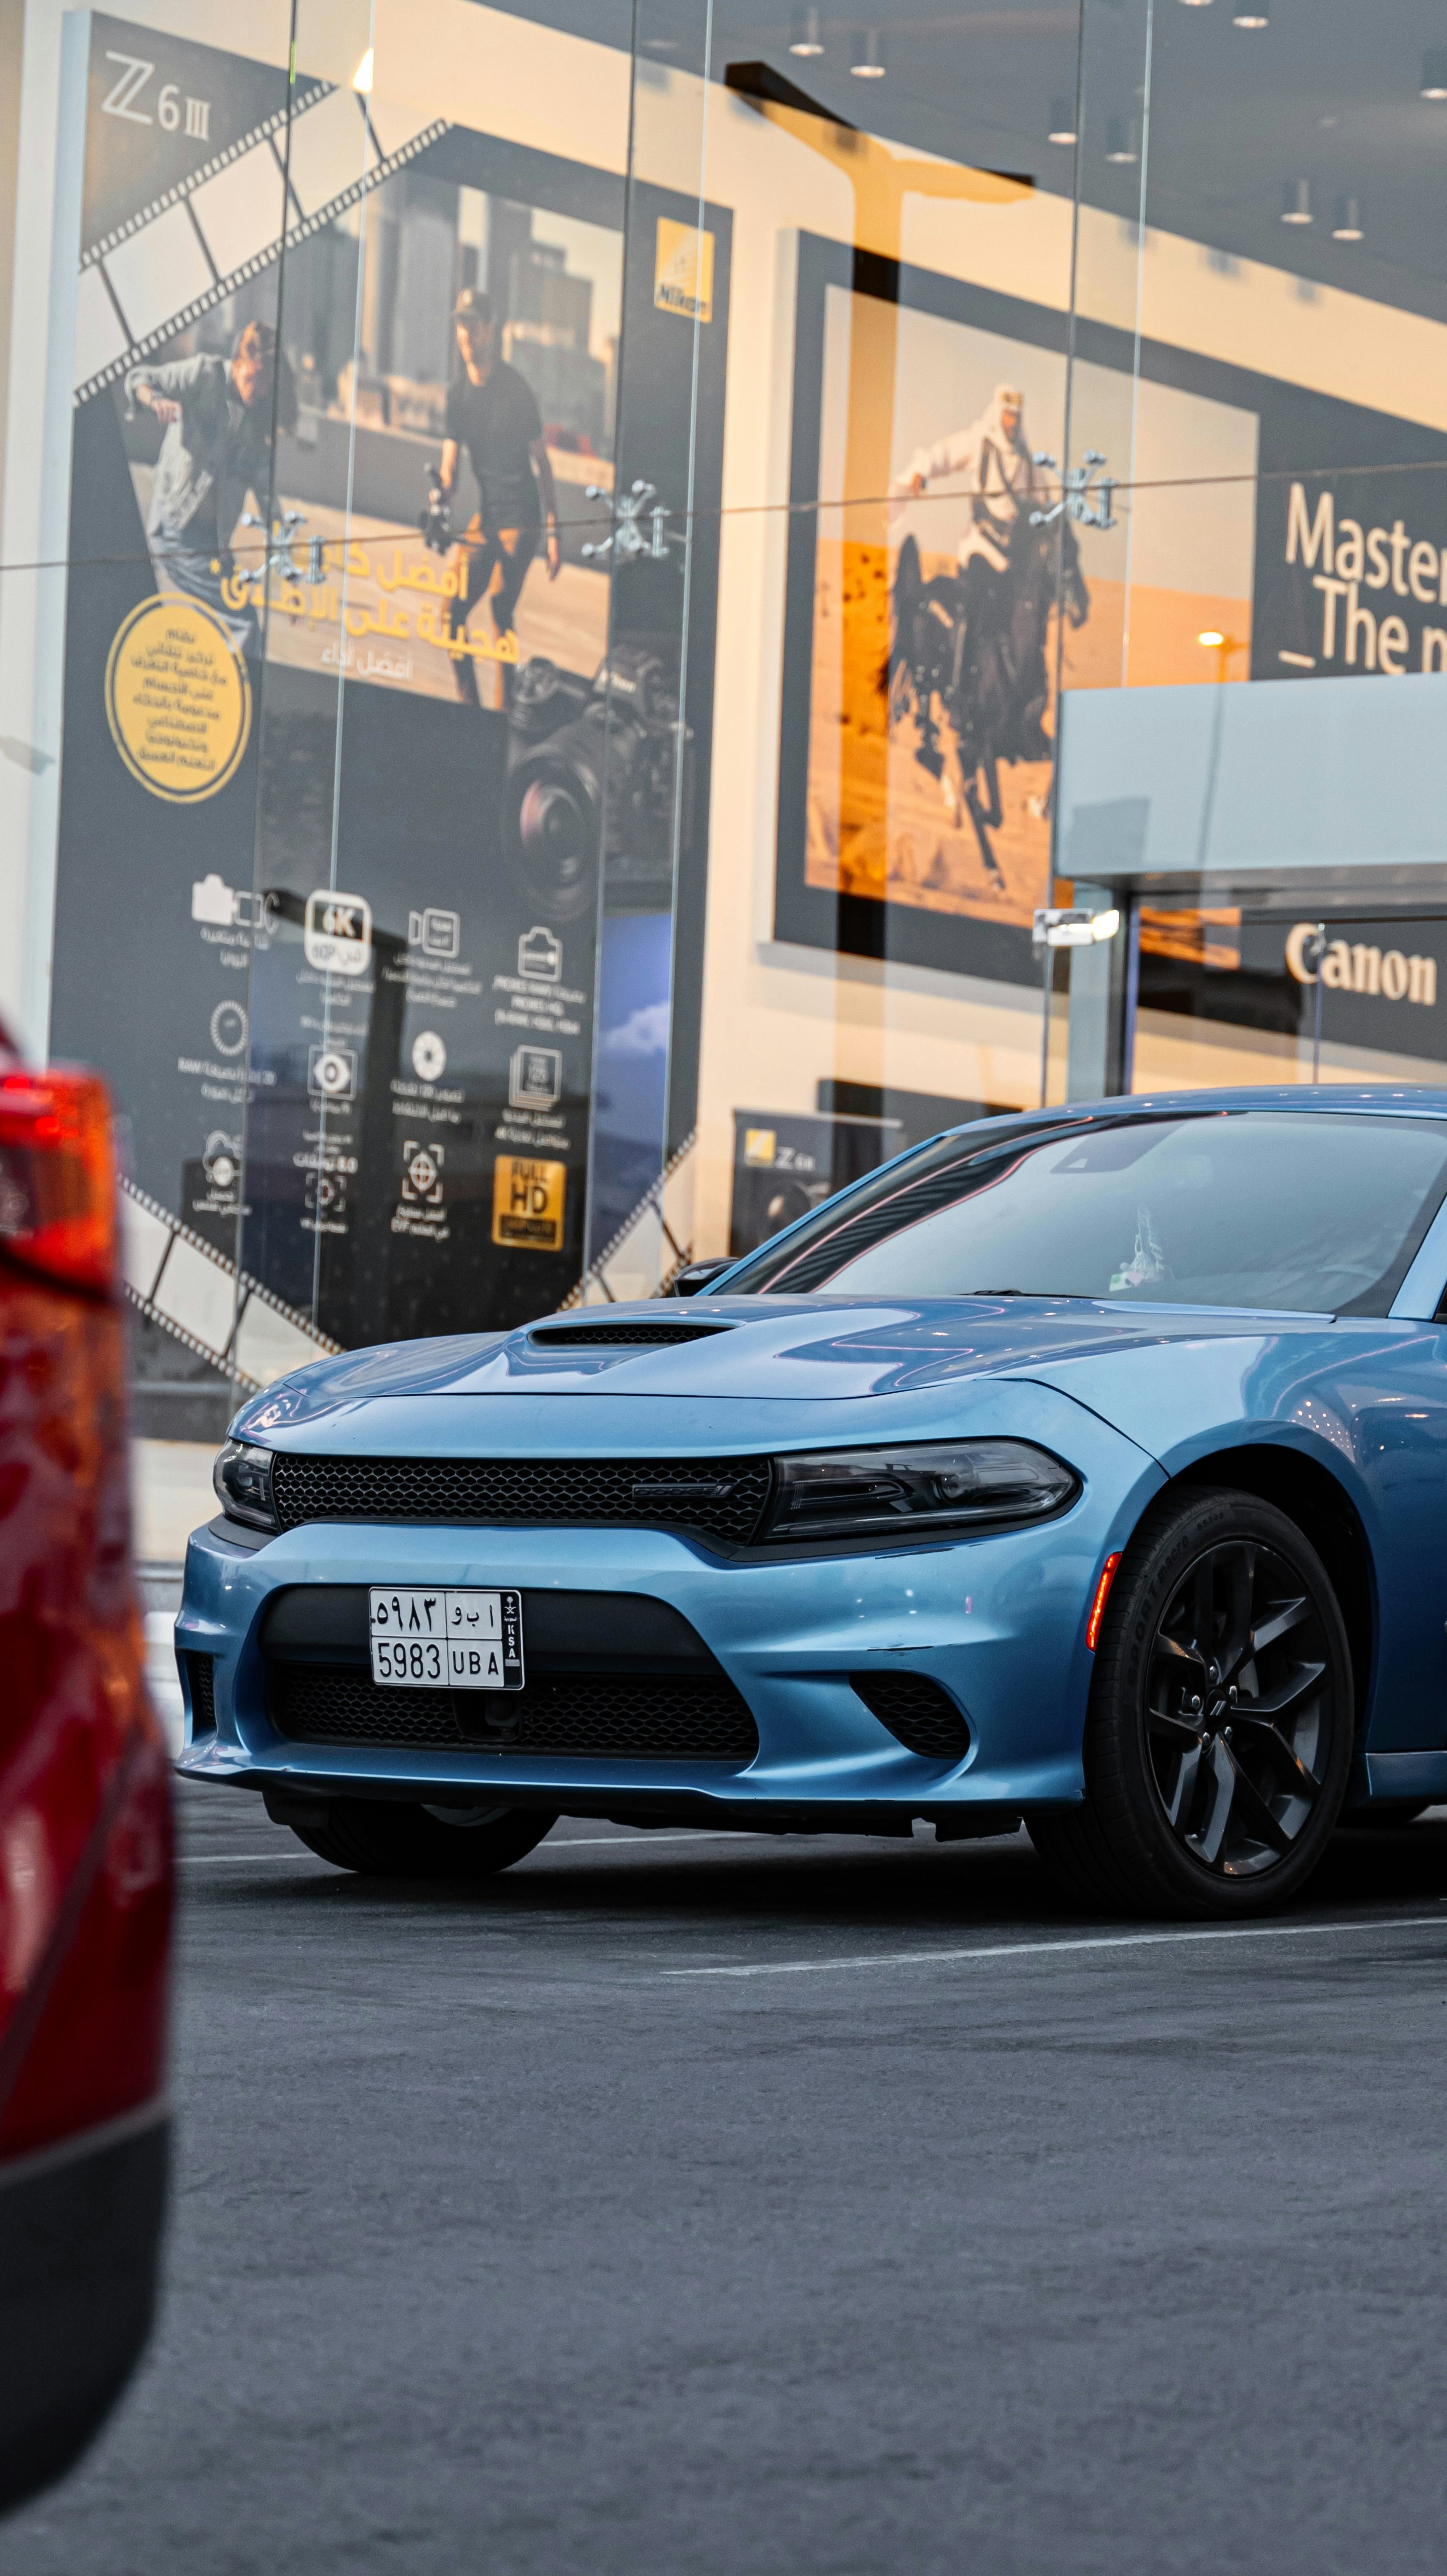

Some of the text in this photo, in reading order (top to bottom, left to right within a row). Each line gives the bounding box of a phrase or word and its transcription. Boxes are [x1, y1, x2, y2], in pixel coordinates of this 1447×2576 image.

[377, 549, 469, 601] أفضل
[345, 598, 410, 639] على
[416, 601, 519, 664] هجينة
[356, 649, 413, 680] أفضل
[1285, 922, 1438, 1007] Canon
[510, 1183, 548, 1214] HD
[377, 1595, 437, 1632] ٥٩٨٣
[378, 1642, 441, 1679] 5983
